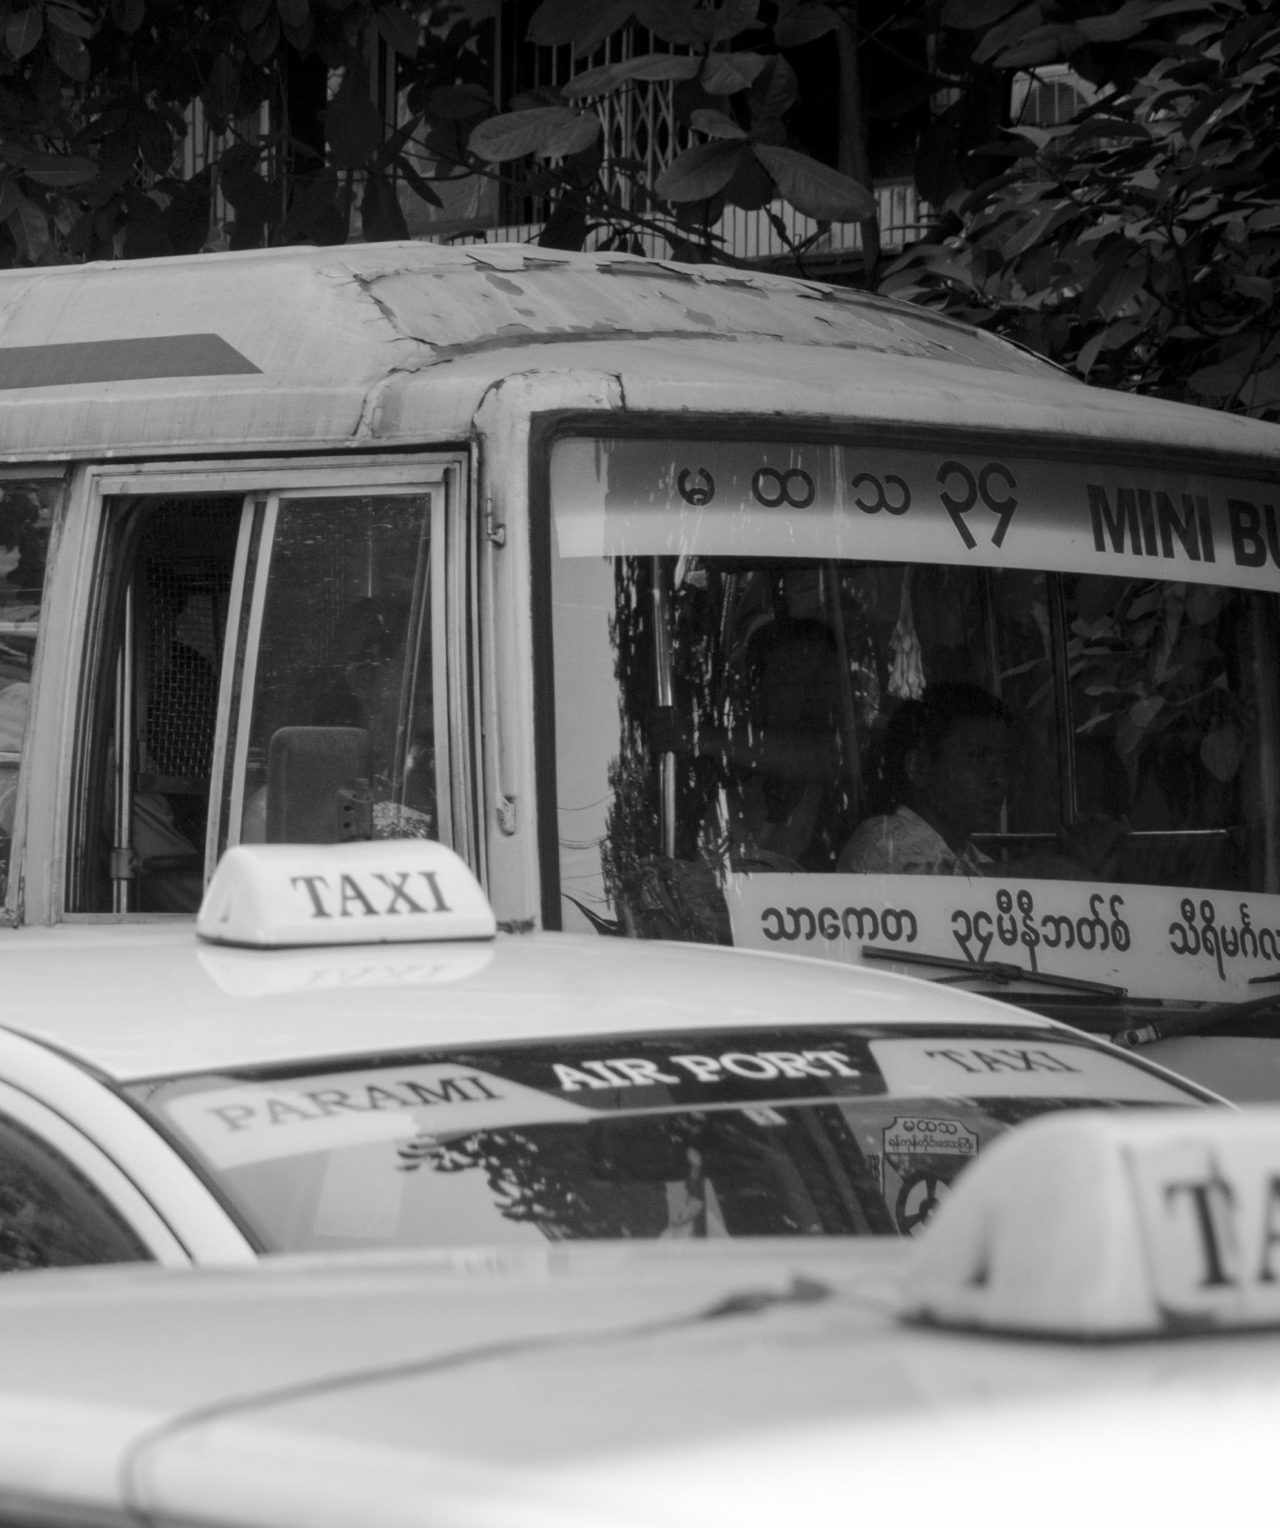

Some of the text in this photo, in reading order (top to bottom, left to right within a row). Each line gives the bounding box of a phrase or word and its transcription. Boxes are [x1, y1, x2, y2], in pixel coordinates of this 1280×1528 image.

[676, 466, 716, 507] မ
[750, 466, 816, 509] ထ
[851, 472, 912, 516] သ
[1087, 484, 1216, 563] MINI
[290, 870, 454, 918] TAXI
[761, 906, 918, 943] သာကေတ
[206, 1049, 1083, 1132] PARAMI AIR PORT TAXI
